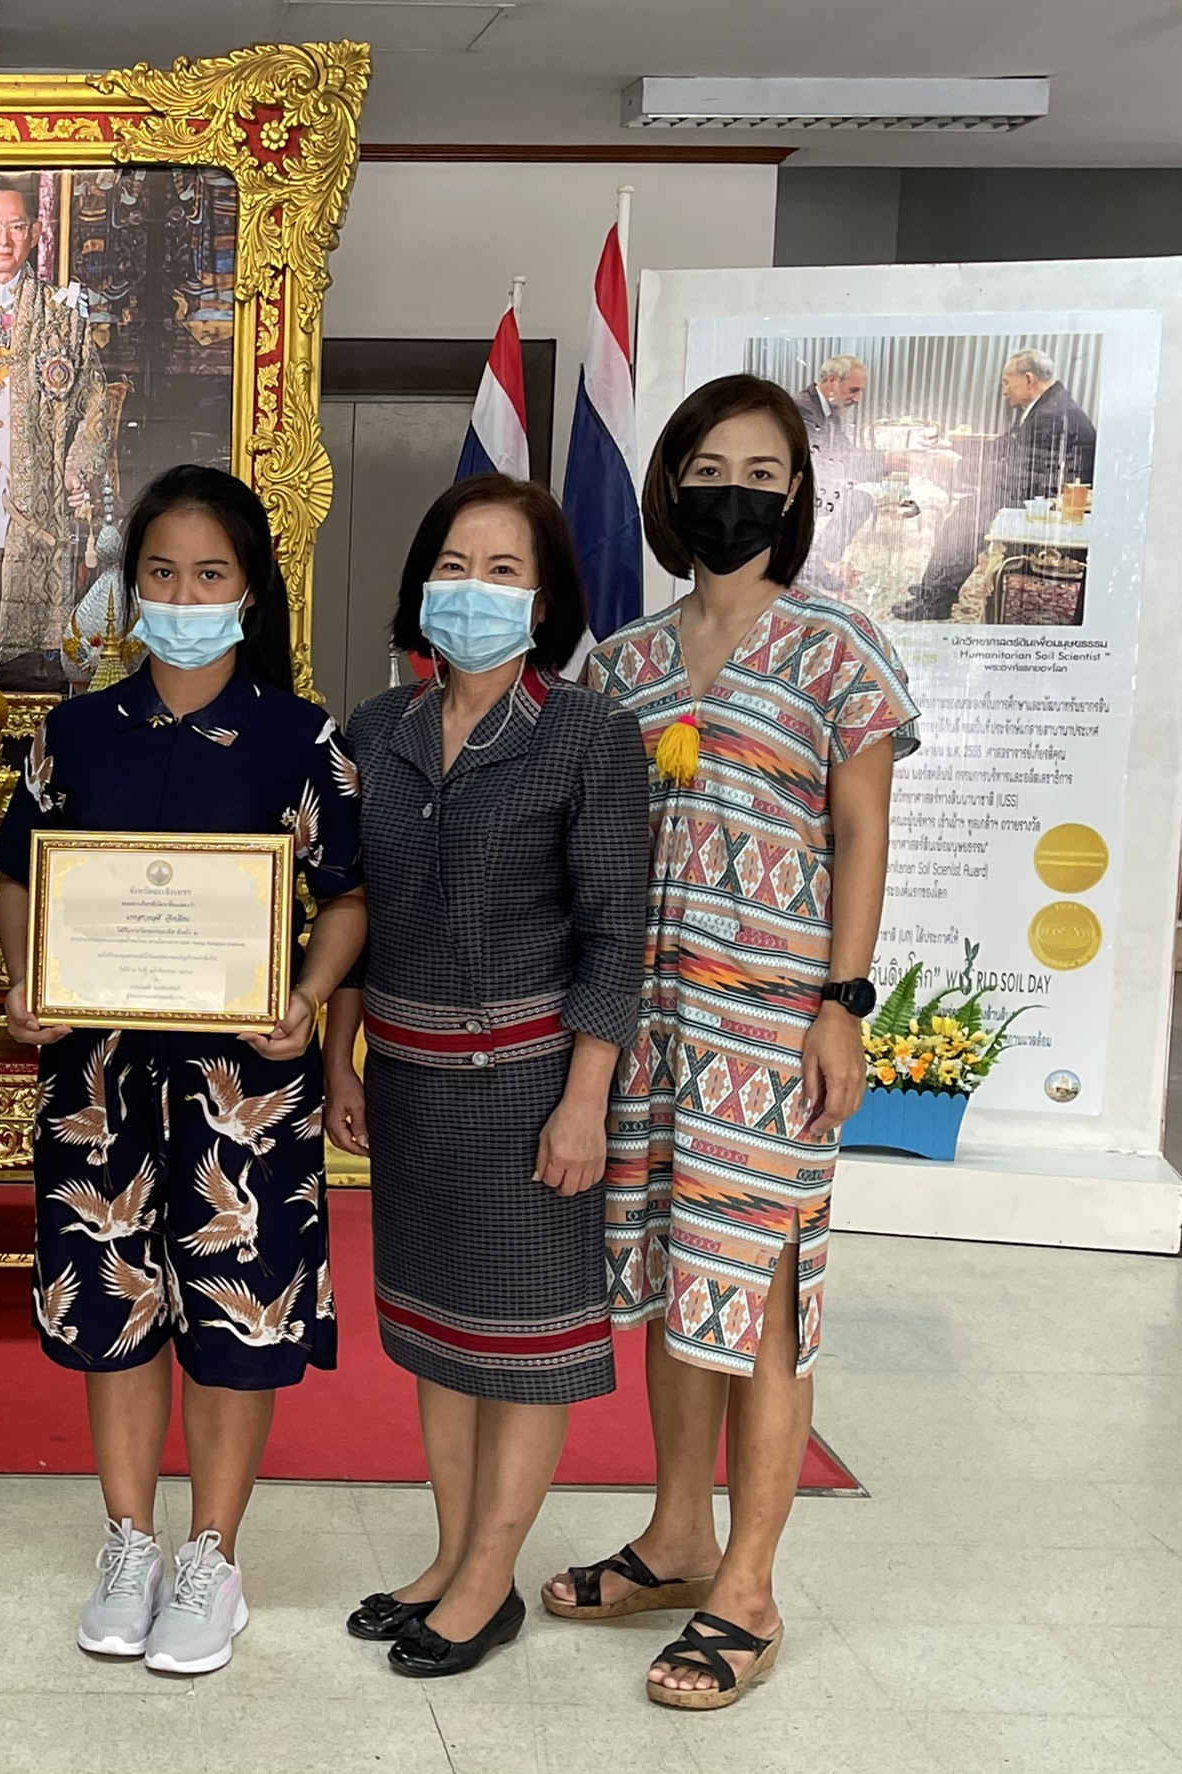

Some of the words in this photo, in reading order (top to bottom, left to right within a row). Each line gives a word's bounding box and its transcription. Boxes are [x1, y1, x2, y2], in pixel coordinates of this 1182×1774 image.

[960, 650, 1031, 660] Humanitarian
[1035, 651, 1054, 660] Soil
[1058, 651, 1101, 661] Scientist
[963, 745, 982, 758] 2555
[1000, 816, 1041, 832] ถวายรางวัล
[1000, 972, 1024, 993] SOIL
[1027, 974, 1052, 994] DAY
